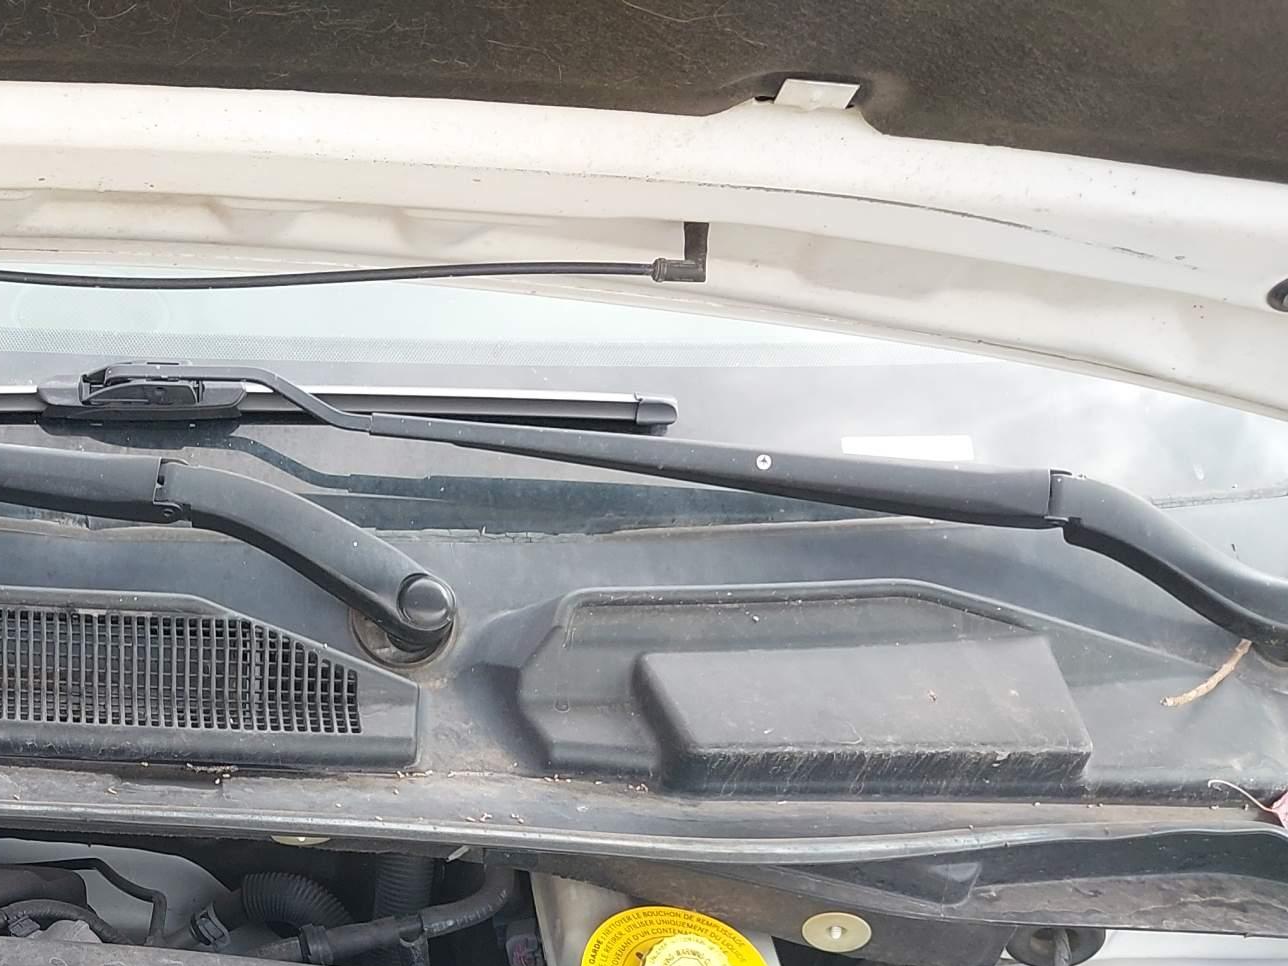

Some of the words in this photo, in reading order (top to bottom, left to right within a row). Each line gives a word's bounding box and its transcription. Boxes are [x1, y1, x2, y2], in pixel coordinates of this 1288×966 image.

[625, 919, 655, 934] UTILISER
[656, 918, 708, 934] UNIQUEMENT
[710, 931, 722, 941] DU
[632, 912, 640, 920] LE
[642, 910, 681, 918] BOUCHON
[683, 911, 694, 921] DE
[695, 917, 746, 948] REMPLISSAGE
[633, 929, 650, 942] D'UN
